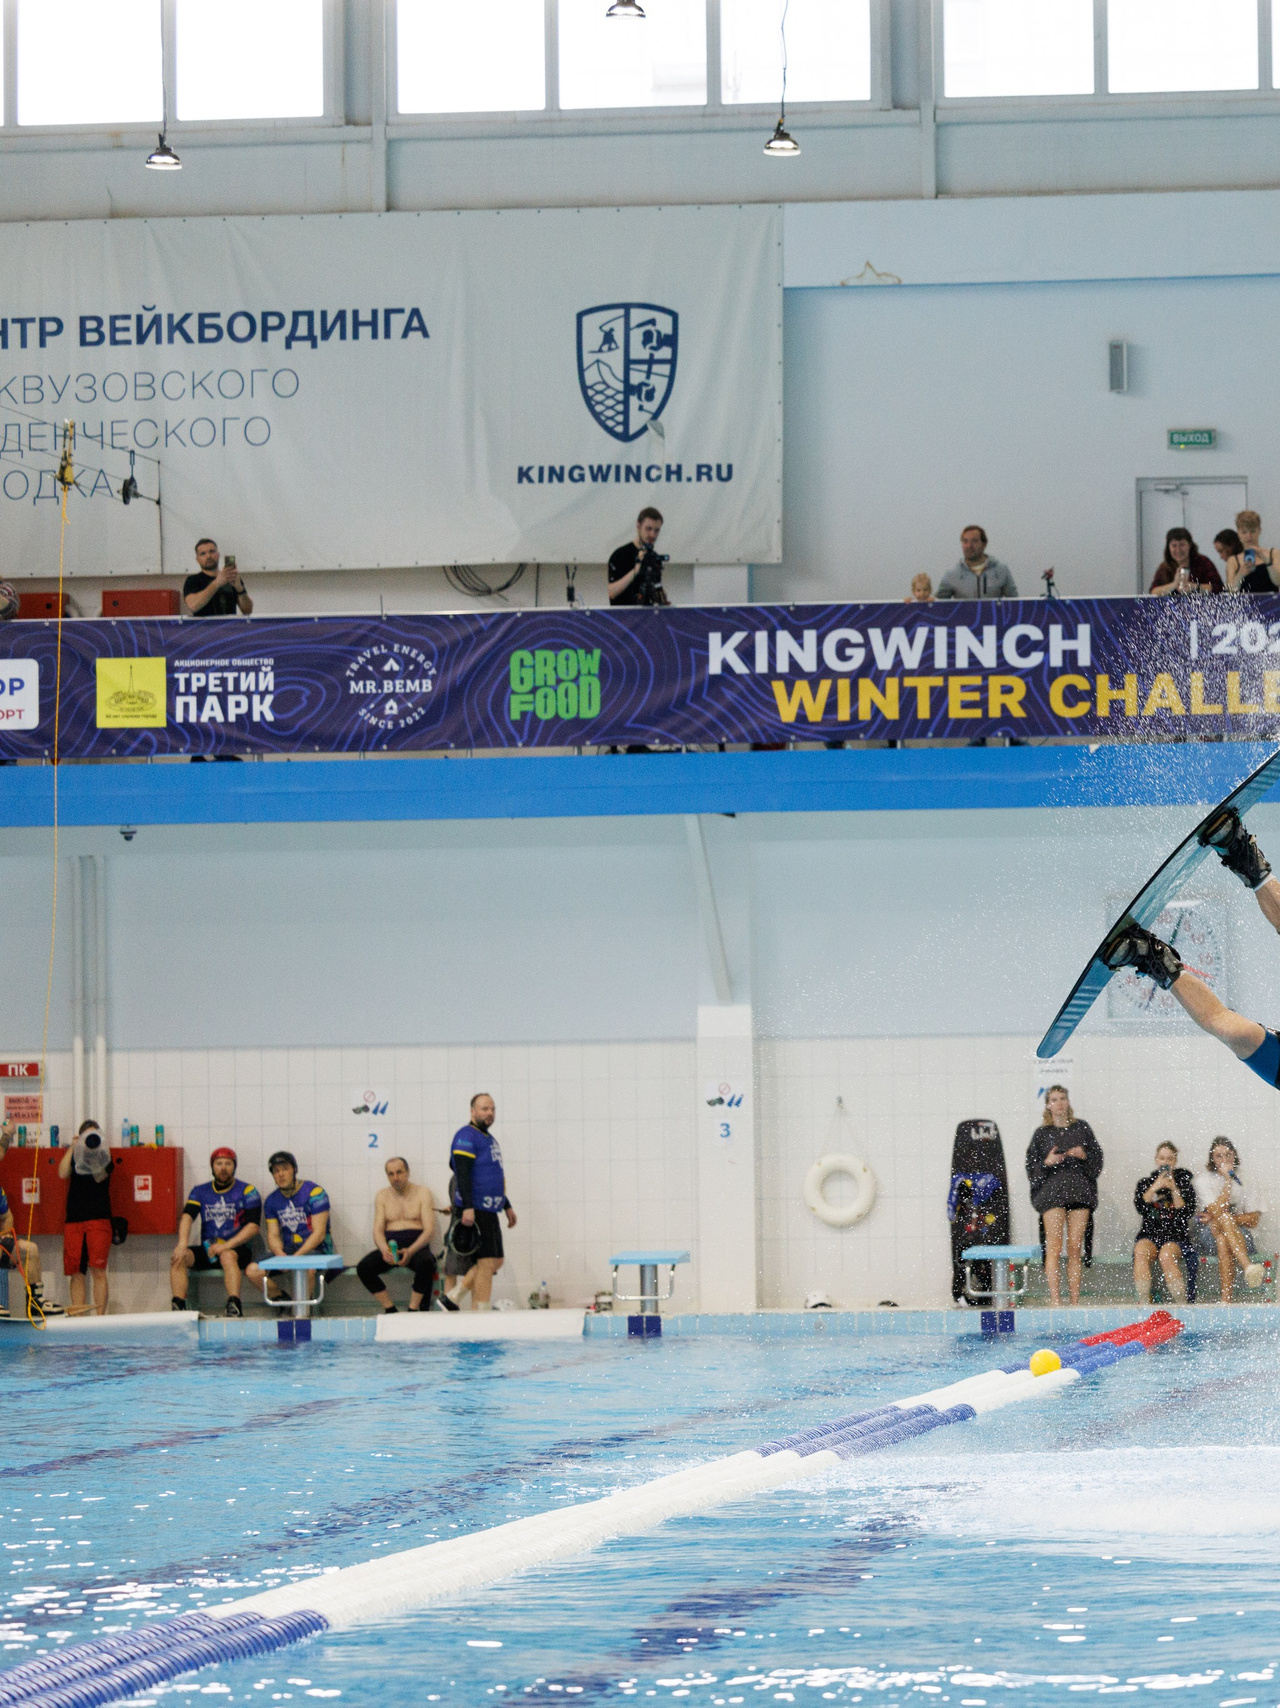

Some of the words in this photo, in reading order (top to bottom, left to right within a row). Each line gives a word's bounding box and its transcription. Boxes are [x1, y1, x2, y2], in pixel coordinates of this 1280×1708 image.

[79, 304, 430, 350] ВЕЙКБОРДИНГА
[1172, 432, 1210, 444] ВЫХОД
[517, 463, 733, 484] KINGWINCH.RU
[346, 644, 388, 678] TRAVEL
[393, 643, 437, 677] ENERGY
[708, 622, 1091, 675] KINGWINCH
[174, 658, 230, 668] АКЦИОНЕРНОЕ
[231, 657, 275, 667] ОБЩЕСТВО
[509, 648, 602, 693] GROW
[174, 665, 275, 693] ТРЕТИЙ
[349, 678, 433, 694] MR.BEMB
[175, 694, 275, 723] ПАРК
[509, 674, 602, 721] FOOD
[771, 674, 1028, 723] WINTER
[358, 707, 394, 730] SINCE
[398, 706, 427, 729] 2022
[8, 1064, 29, 1077] ПК
[368, 1133, 379, 1148] 2
[720, 1122, 731, 1138] 3
